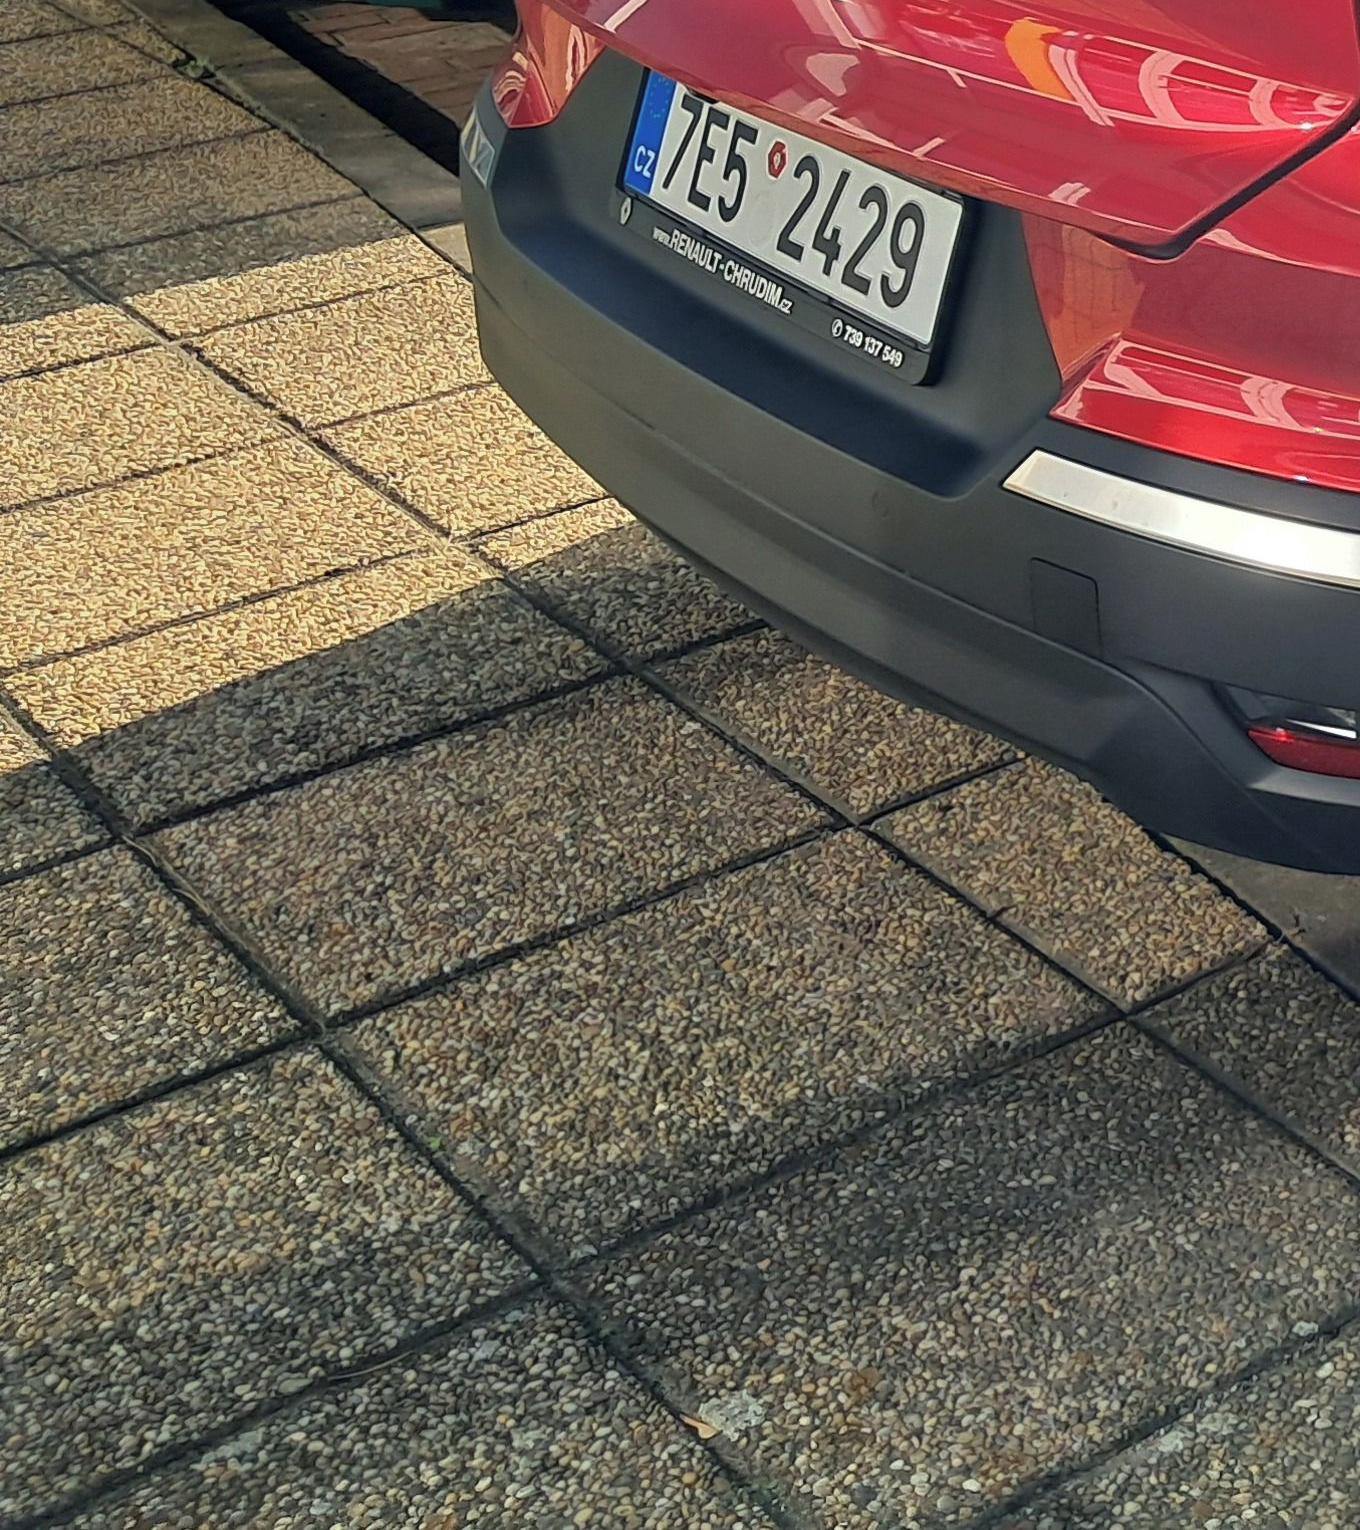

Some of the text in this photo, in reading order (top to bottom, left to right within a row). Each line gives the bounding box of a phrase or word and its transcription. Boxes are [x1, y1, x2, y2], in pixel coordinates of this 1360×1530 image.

[634, 145, 656, 179] CZ
[661, 95, 926, 309] 7E5 2429
[843, 324, 903, 368] 739 137 549
